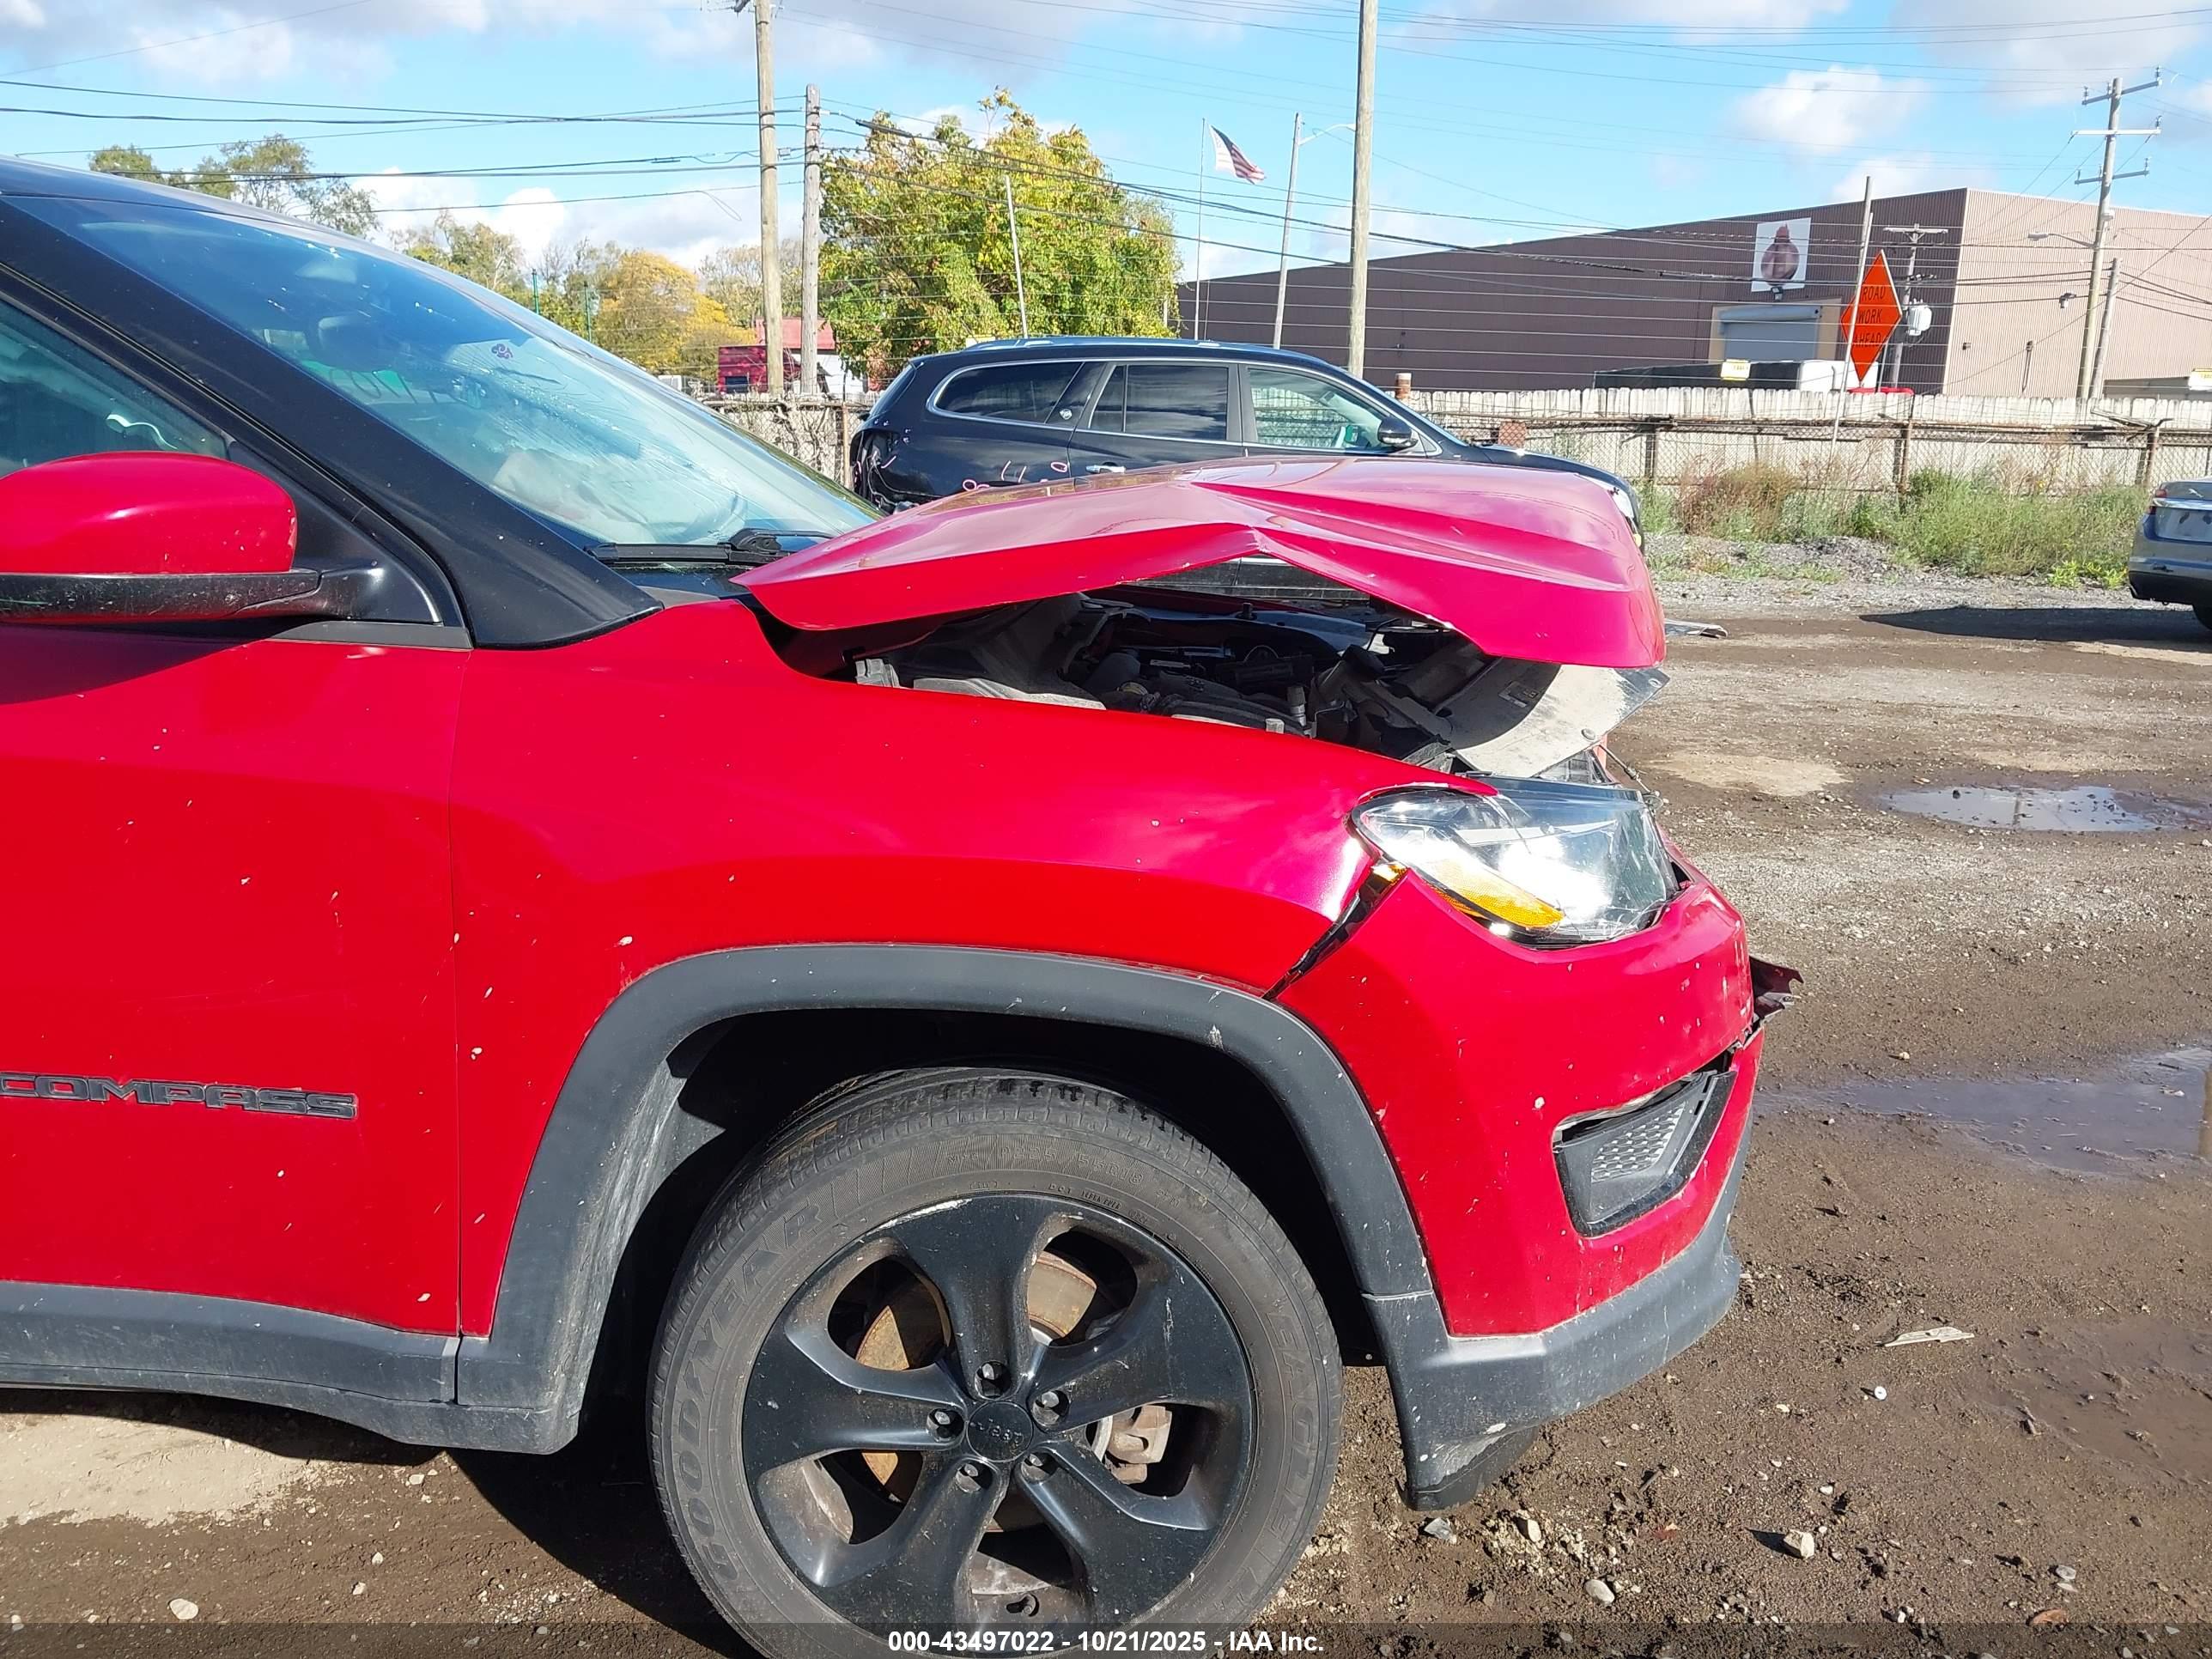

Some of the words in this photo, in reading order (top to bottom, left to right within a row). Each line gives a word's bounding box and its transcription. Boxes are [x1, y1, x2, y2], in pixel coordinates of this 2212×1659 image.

[1862, 286, 1886, 300] ROAD
[1857, 308, 1882, 324] WORK
[1852, 331, 1881, 347] AHEAD
[0, 1070, 359, 1120] COMPASS
[674, 1200, 824, 1583] GOODYEAR
